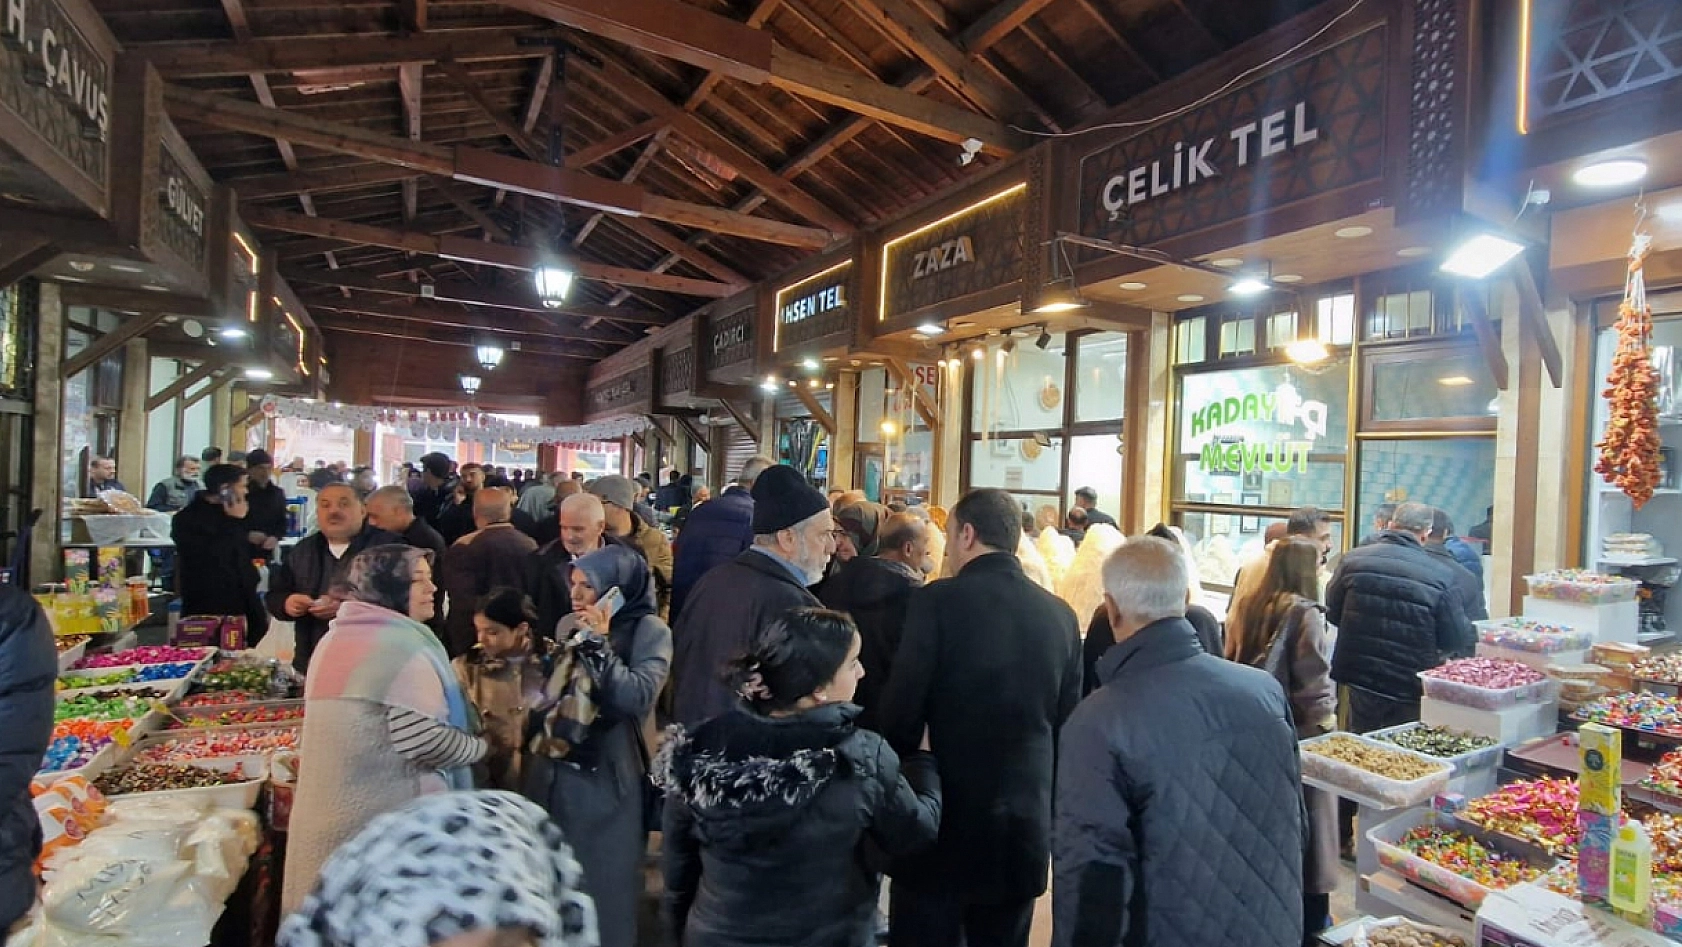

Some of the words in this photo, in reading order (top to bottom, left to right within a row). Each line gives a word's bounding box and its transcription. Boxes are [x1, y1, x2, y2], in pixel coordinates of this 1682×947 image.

[42, 28, 108, 142] ÇAVUŞ
[1102, 137, 1215, 222] ÇELİK
[1230, 101, 1318, 168] TEL
[912, 235, 976, 280] ZAZA
[819, 285, 848, 313] TEL
